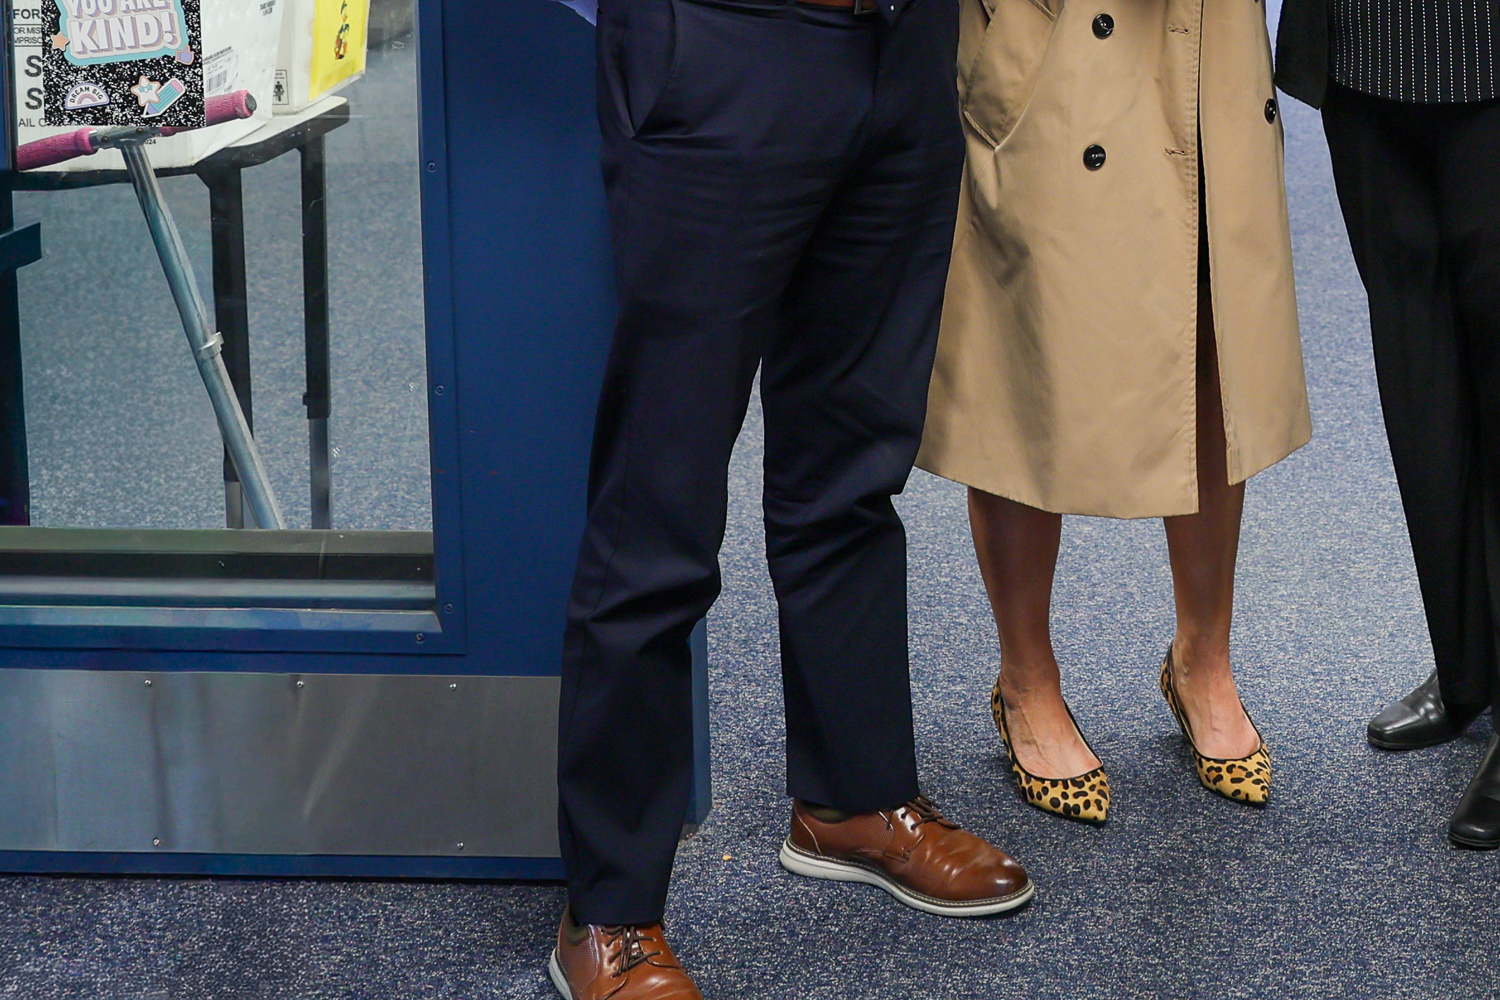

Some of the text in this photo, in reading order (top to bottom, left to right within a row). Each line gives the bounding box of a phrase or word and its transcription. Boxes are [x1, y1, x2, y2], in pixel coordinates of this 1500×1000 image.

[13, 9, 41, 20] FOR
[70, 12, 177, 54] KIND!
[69, 86, 104, 103] DREAM BIG
[18, 118, 36, 127] AIL
